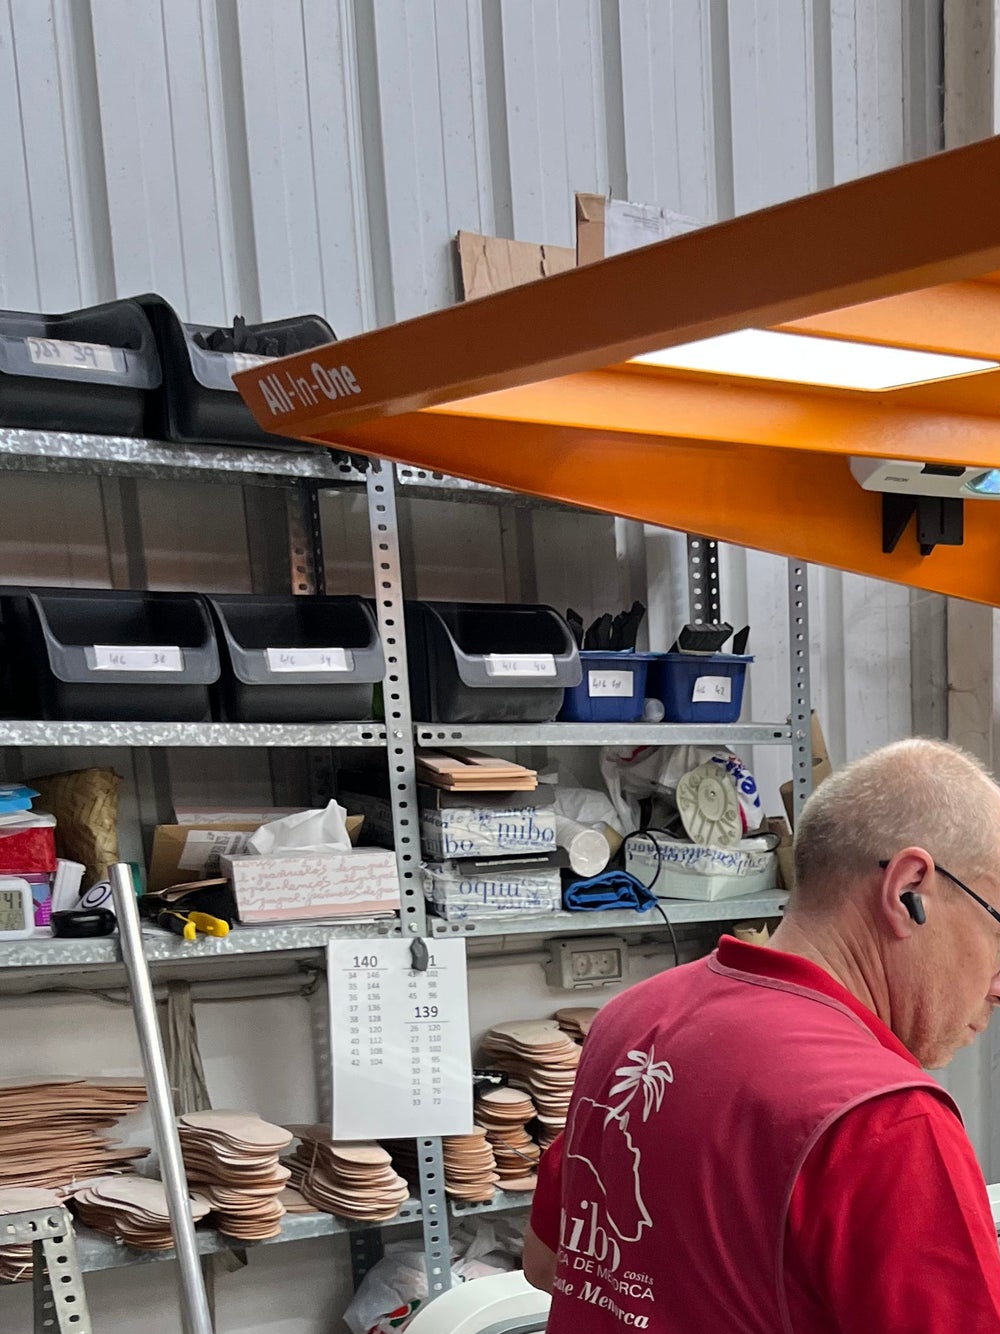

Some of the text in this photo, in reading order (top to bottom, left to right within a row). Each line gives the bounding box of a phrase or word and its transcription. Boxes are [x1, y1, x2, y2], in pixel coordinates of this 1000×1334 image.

[258, 362, 362, 416] All-In-One
[498, 816, 555, 842] mibo
[353, 955, 378, 968] 140
[414, 1005, 439, 1018] 139
[573, 1256, 595, 1274] DE
[596, 1264, 655, 1302] MEORCA
